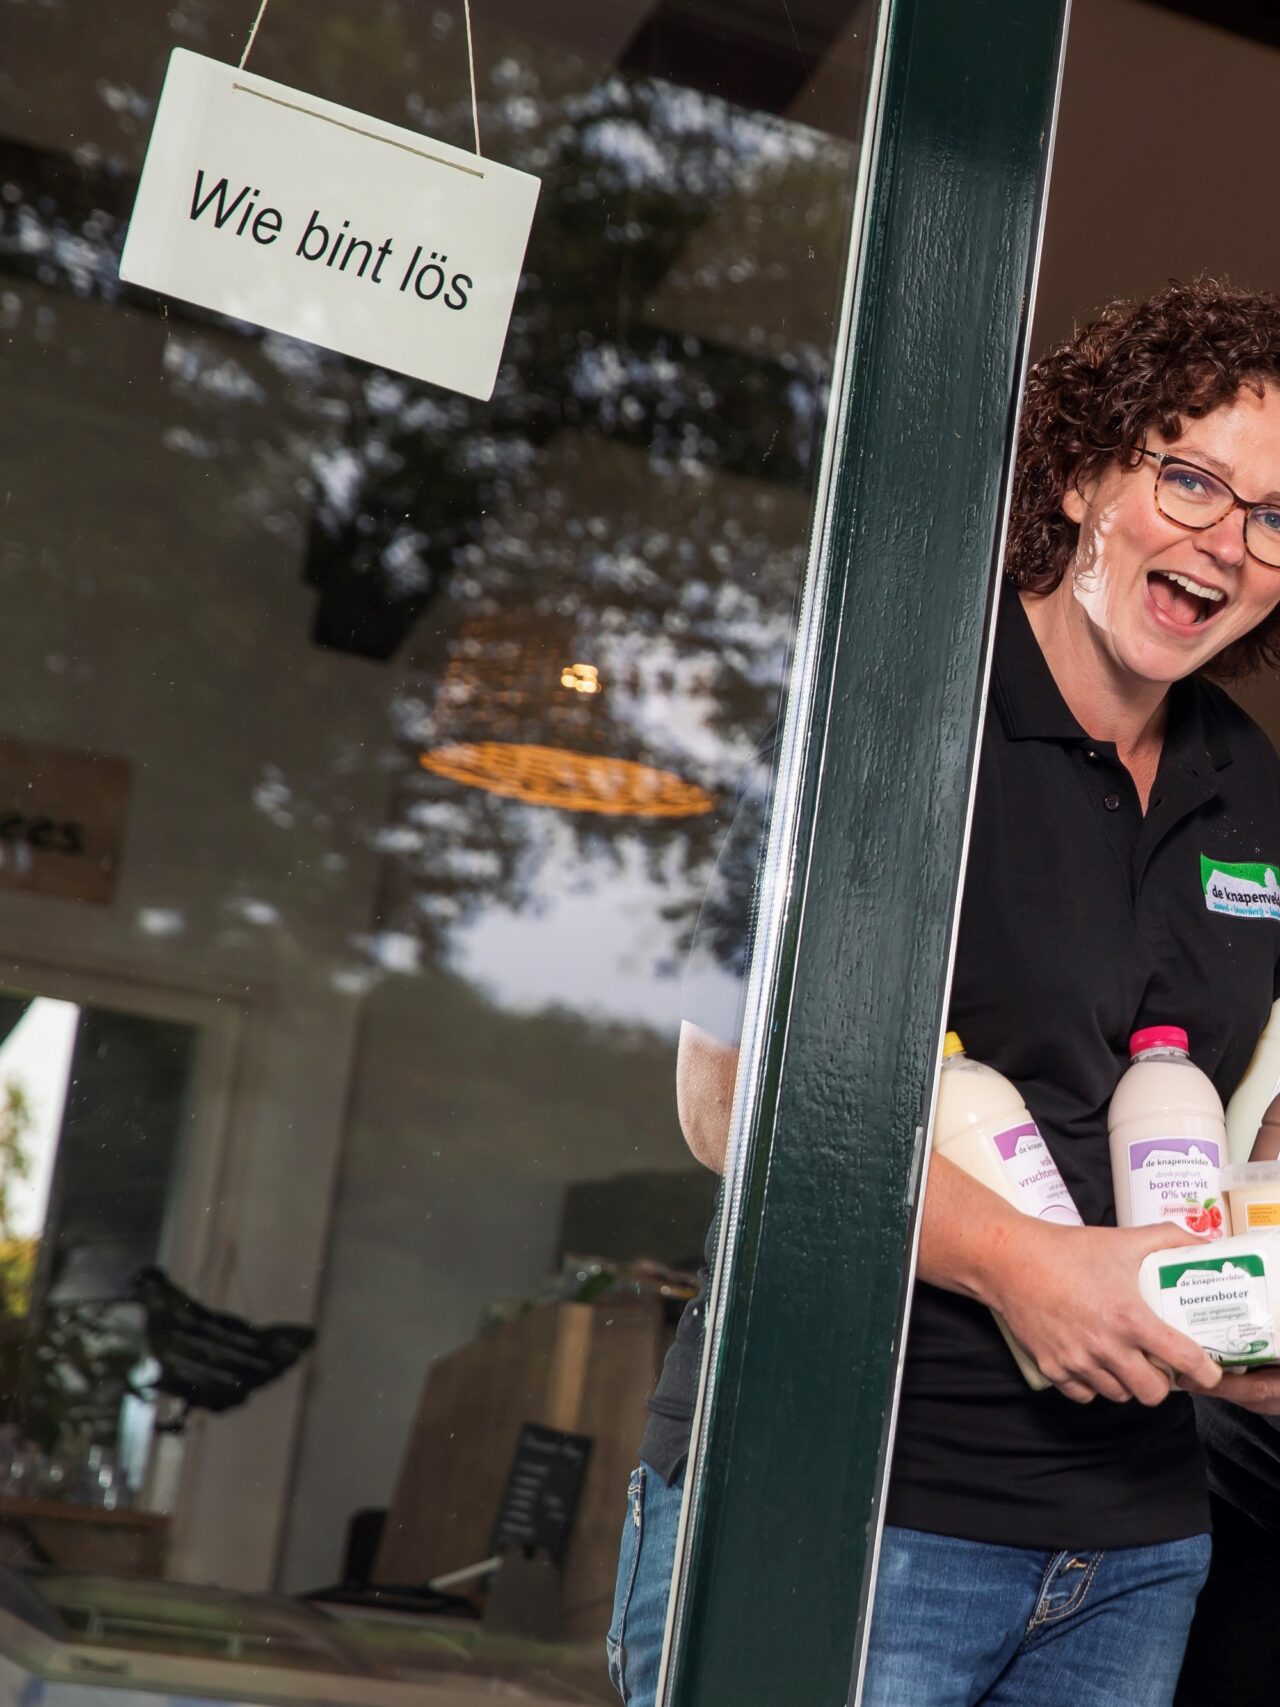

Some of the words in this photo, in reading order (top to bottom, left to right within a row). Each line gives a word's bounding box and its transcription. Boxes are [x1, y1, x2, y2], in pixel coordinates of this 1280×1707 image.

[189, 169, 283, 245] Wie
[296, 210, 393, 284] bint
[399, 245, 474, 311] lös
[1212, 885, 1224, 899] de
[1145, 1159, 1156, 1167] de
[1157, 1158, 1209, 1166] knapenvelder
[1149, 1179, 1208, 1190] boeren-vit
[1161, 1190, 1179, 1200] 0%
[1180, 1190, 1198, 1199] vet
[1180, 1279, 1190, 1287] de
[1179, 1290, 1249, 1306] boerenboter
